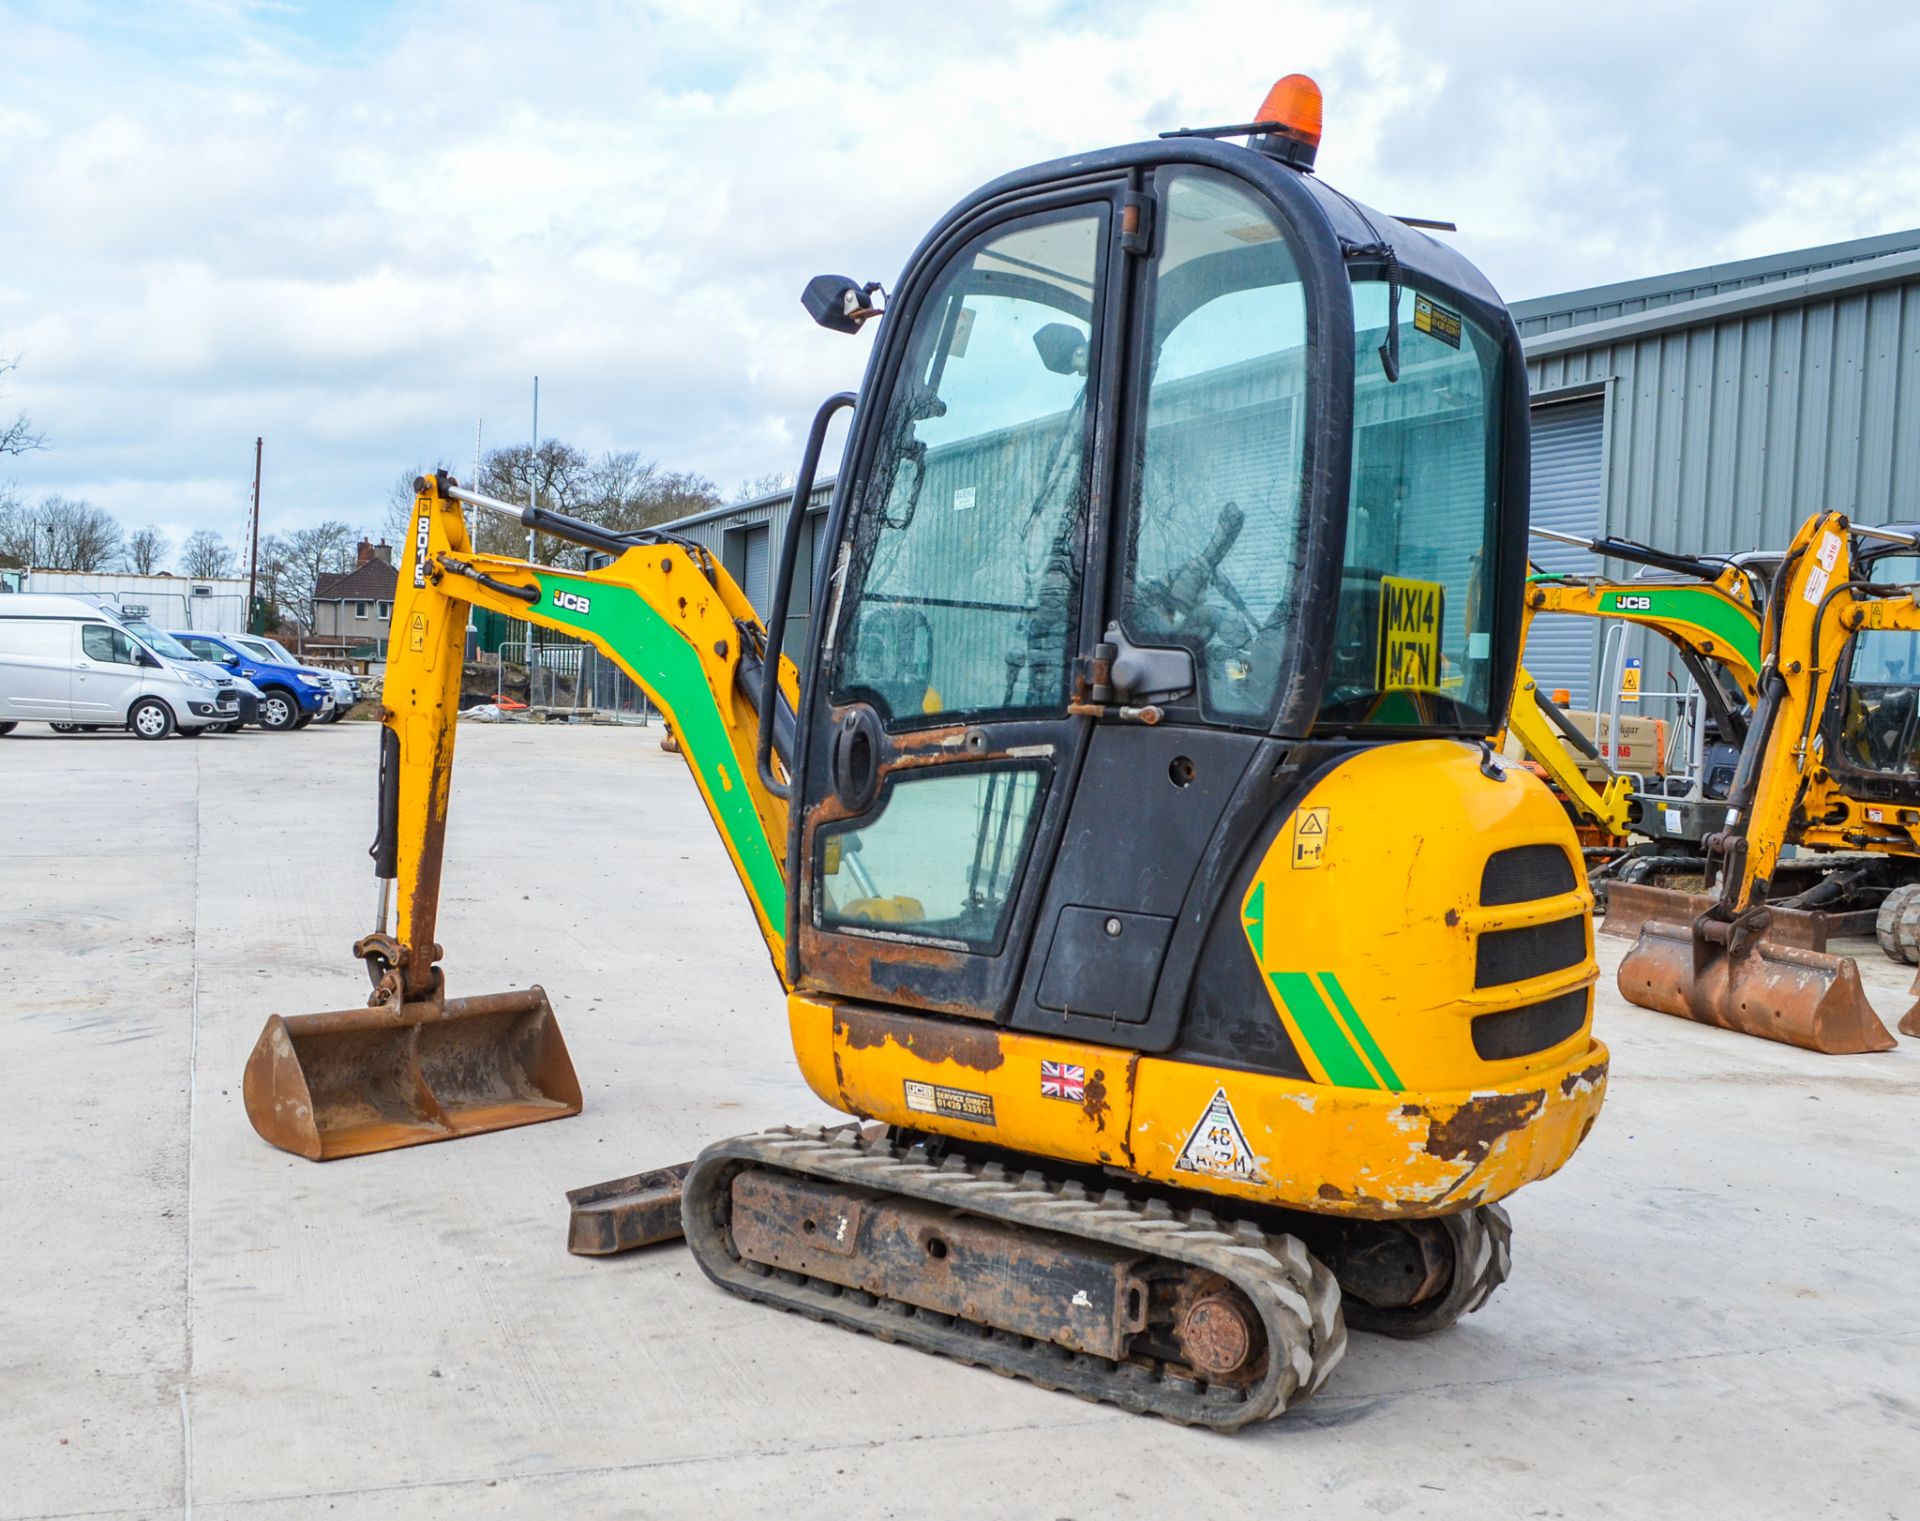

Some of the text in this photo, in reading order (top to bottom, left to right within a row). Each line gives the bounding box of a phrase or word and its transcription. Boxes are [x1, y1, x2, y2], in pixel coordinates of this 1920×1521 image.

[553, 590, 590, 614] JCB
[1616, 596, 1650, 610] JCB
[1390, 586, 1434, 634] MX14
[908, 1084, 932, 1098] JCB
[936, 1091, 963, 1104] SERVICE
[965, 1096, 990, 1107] DIRECT
[937, 1099, 961, 1110] 01420
